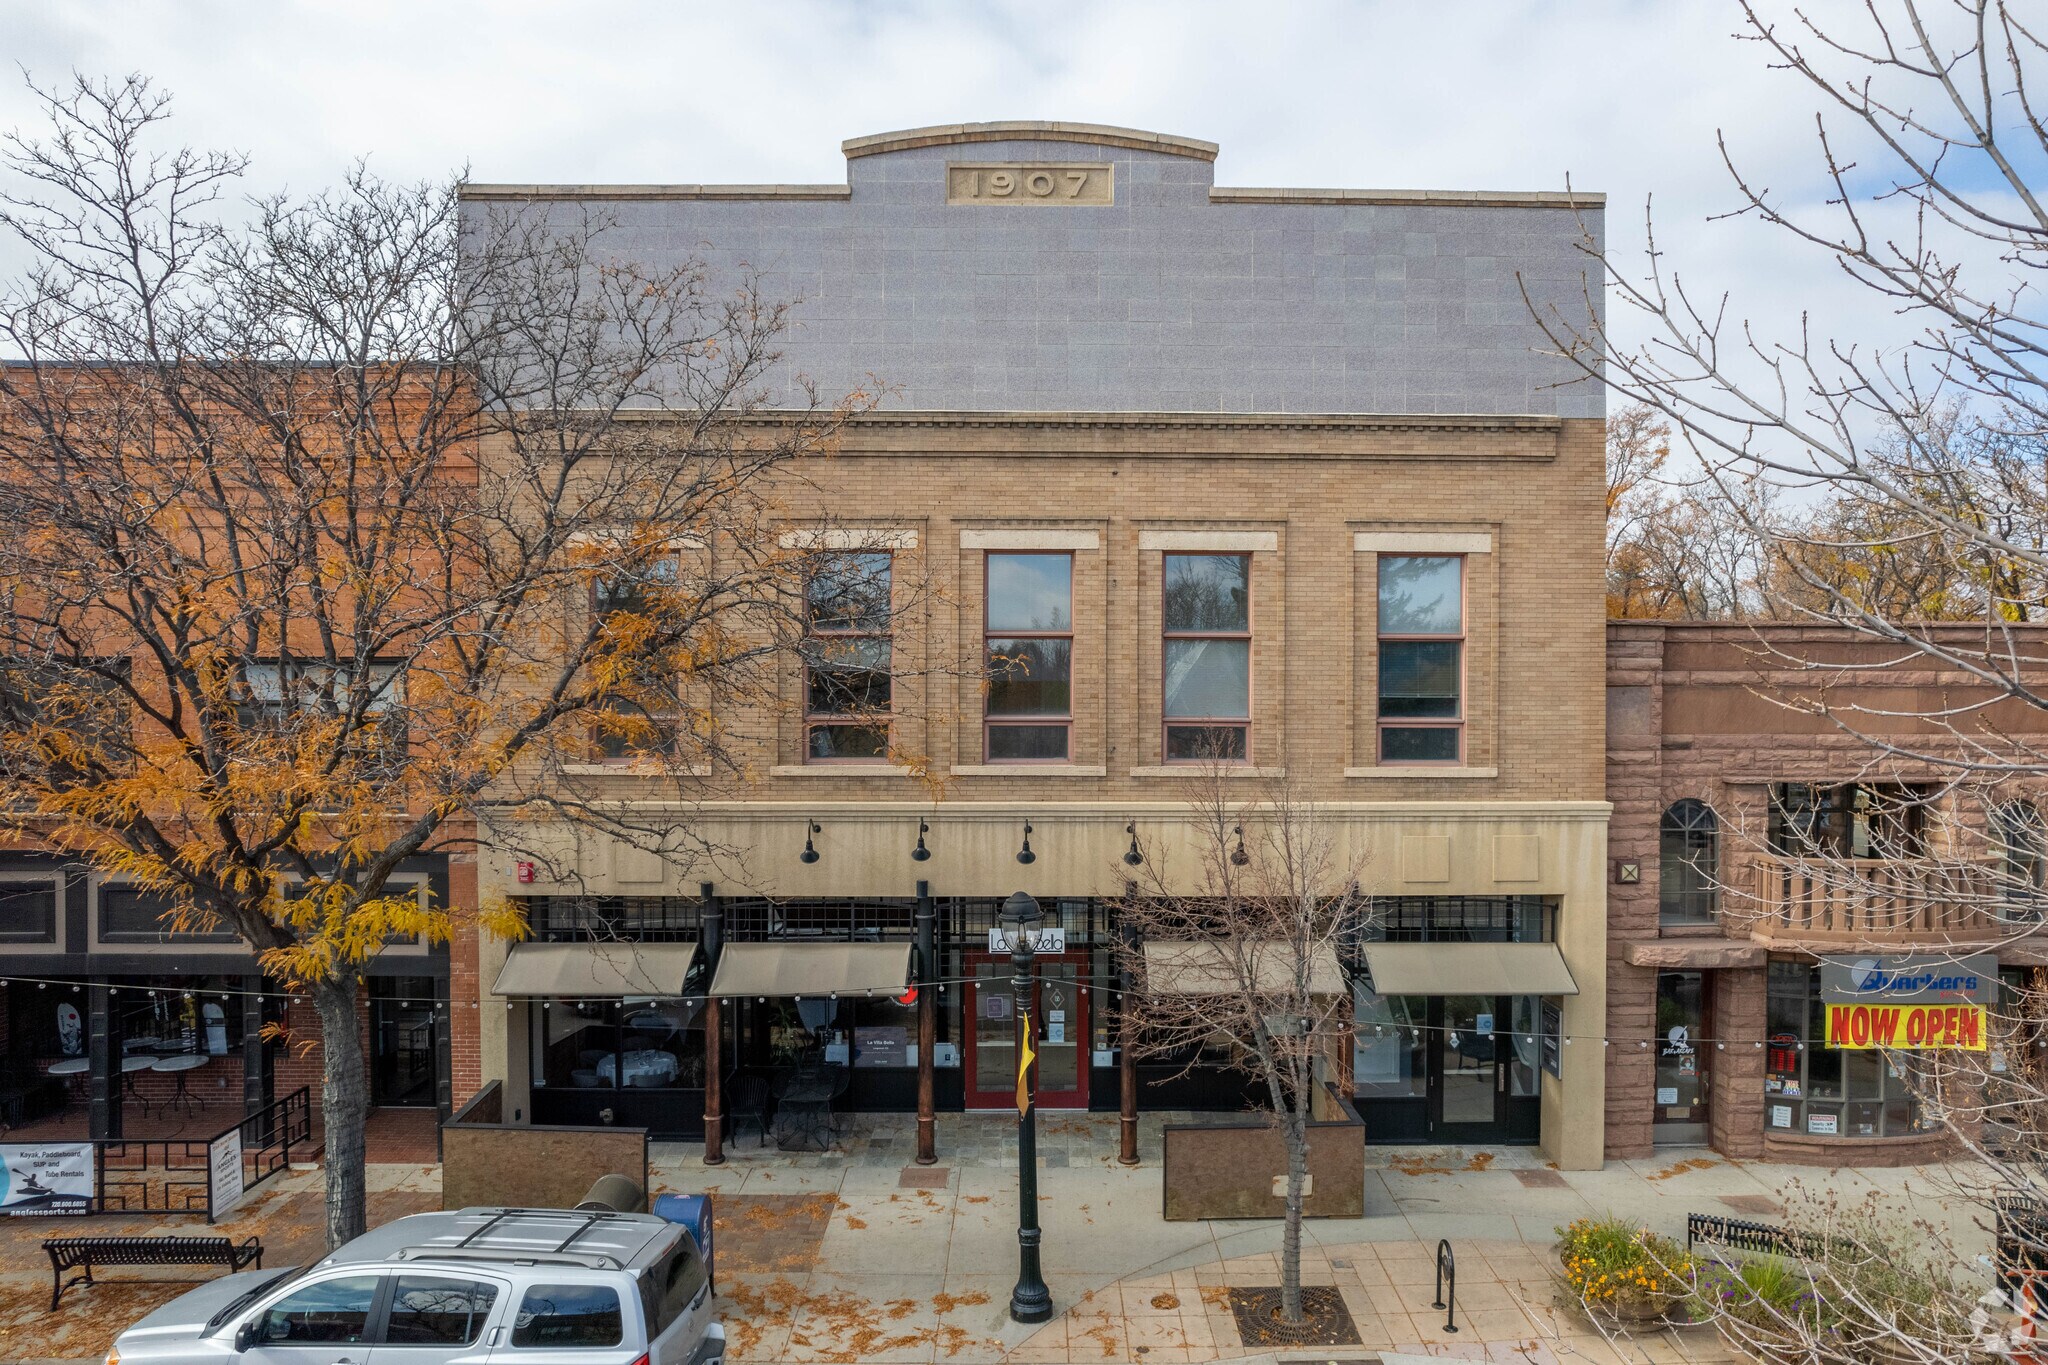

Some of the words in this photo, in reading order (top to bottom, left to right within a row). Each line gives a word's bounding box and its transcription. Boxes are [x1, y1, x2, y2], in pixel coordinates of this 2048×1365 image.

[971, 171, 1088, 199] 1907
[991, 934, 1007, 950] La
[1831, 1007, 1900, 1046] NOW
[1907, 1008, 1979, 1046] OPEN
